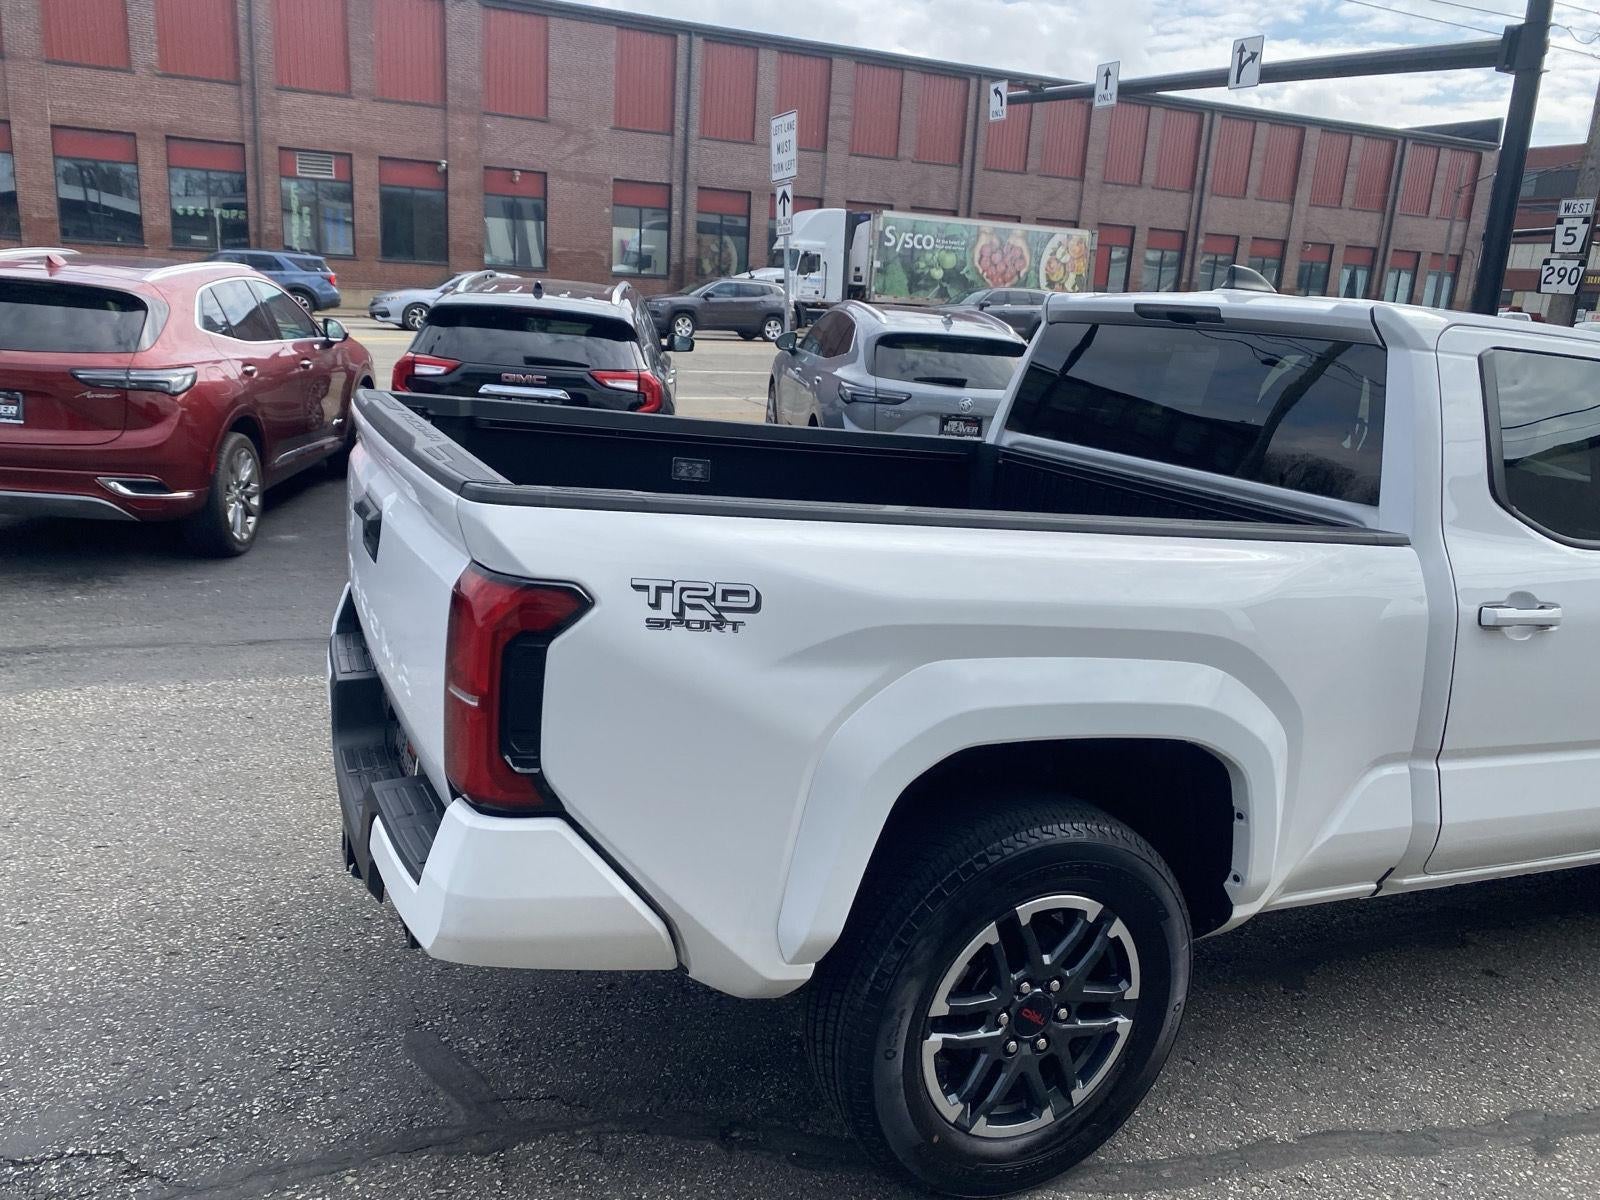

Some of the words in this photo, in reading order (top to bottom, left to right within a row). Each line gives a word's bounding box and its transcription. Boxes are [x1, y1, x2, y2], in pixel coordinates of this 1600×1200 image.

[1098, 92, 1114, 103] ONLY
[991, 109, 1005, 118] ONLY
[773, 124, 783, 137] LEFT
[784, 119, 796, 133] LANE
[776, 139, 792, 156] MUST
[773, 162, 784, 174] TURN
[785, 159, 796, 172] LEFT
[1563, 202, 1591, 214] WEST
[1562, 226, 1578, 246] 5
[1543, 266, 1580, 286] 290
[501, 372, 547, 384] GMC
[943, 424, 979, 434] WEAVER
[630, 577, 762, 620] TRD
[645, 617, 746, 633] SPORT
